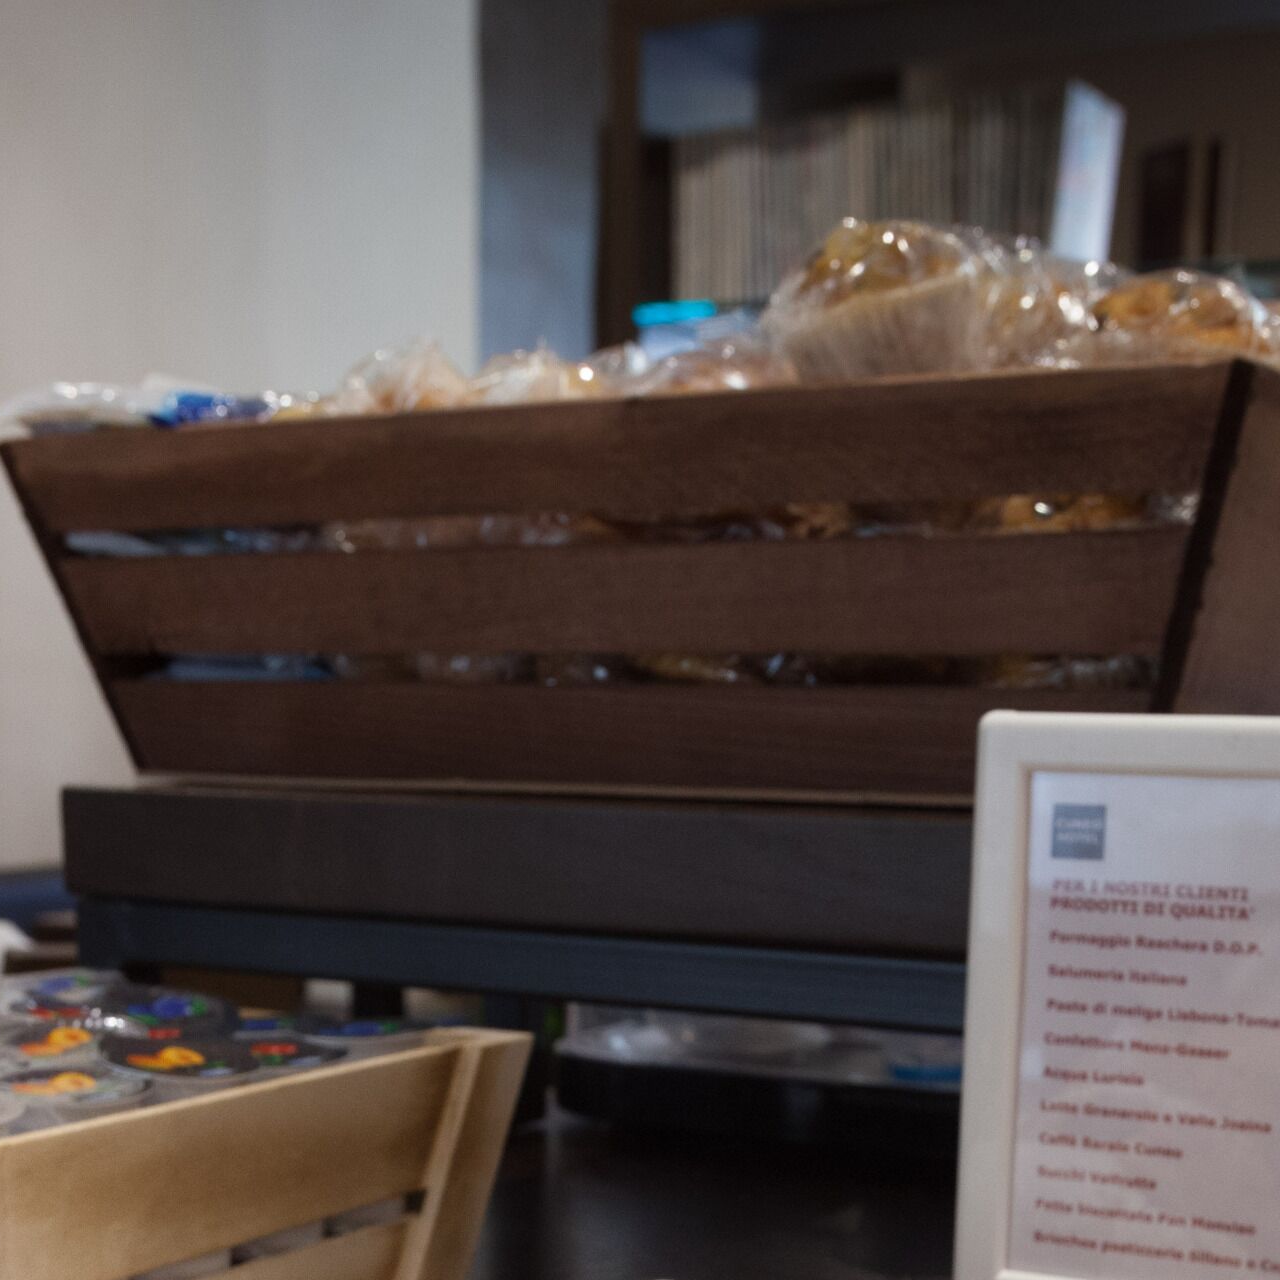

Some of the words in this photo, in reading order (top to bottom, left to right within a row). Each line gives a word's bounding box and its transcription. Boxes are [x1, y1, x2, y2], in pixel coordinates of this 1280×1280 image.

[1052, 879, 1086, 894] PER
[1103, 881, 1170, 898] NOSTRI
[1175, 884, 1250, 902] CLIENTI
[1050, 897, 1138, 915] PRODOTTI
[1143, 902, 1165, 917] DI
[1049, 929, 1132, 948] Formaggio
